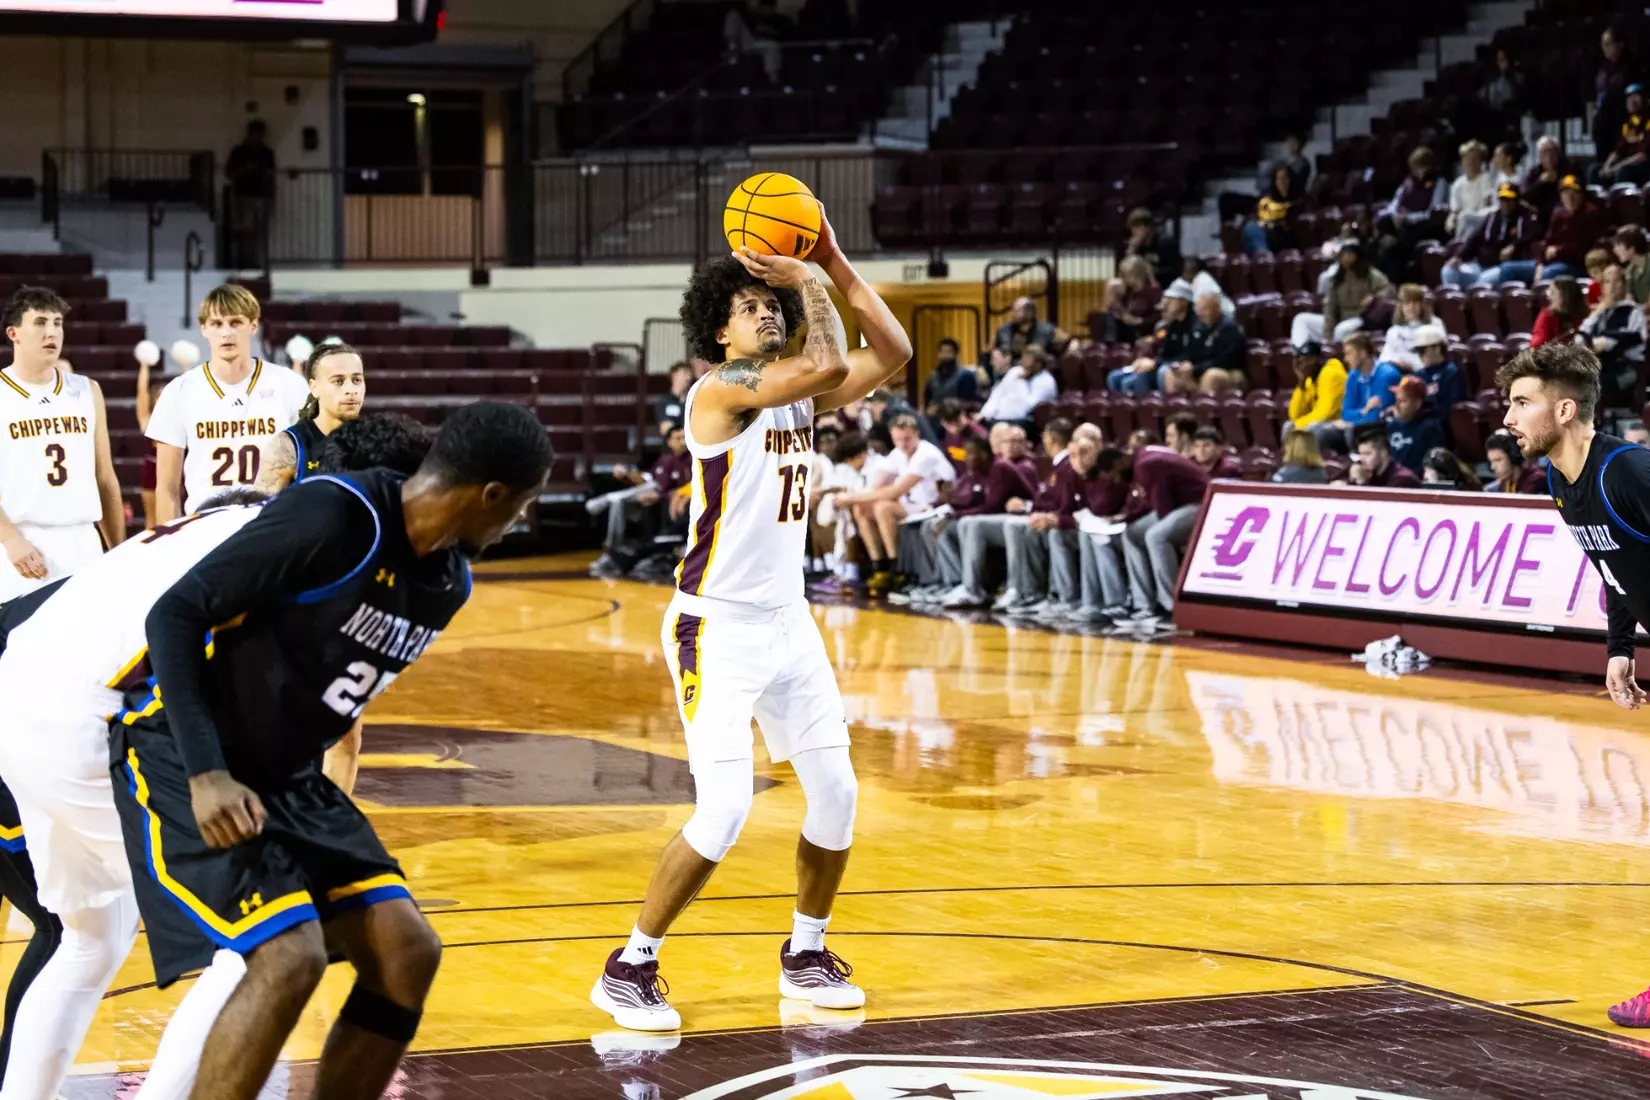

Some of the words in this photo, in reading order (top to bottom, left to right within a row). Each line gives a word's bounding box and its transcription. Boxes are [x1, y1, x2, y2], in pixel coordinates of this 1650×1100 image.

[9, 416, 88, 440] CHIPPEWAS
[196, 417, 276, 439] CHIPPEWAS
[45, 443, 68, 487] 3
[212, 444, 260, 486] 20
[777, 464, 809, 523] 13
[1586, 524, 1621, 551] PARK
[1271, 509, 1556, 610] WELCOME
[339, 602, 411, 658] NORTH
[400, 625, 441, 662] PA
